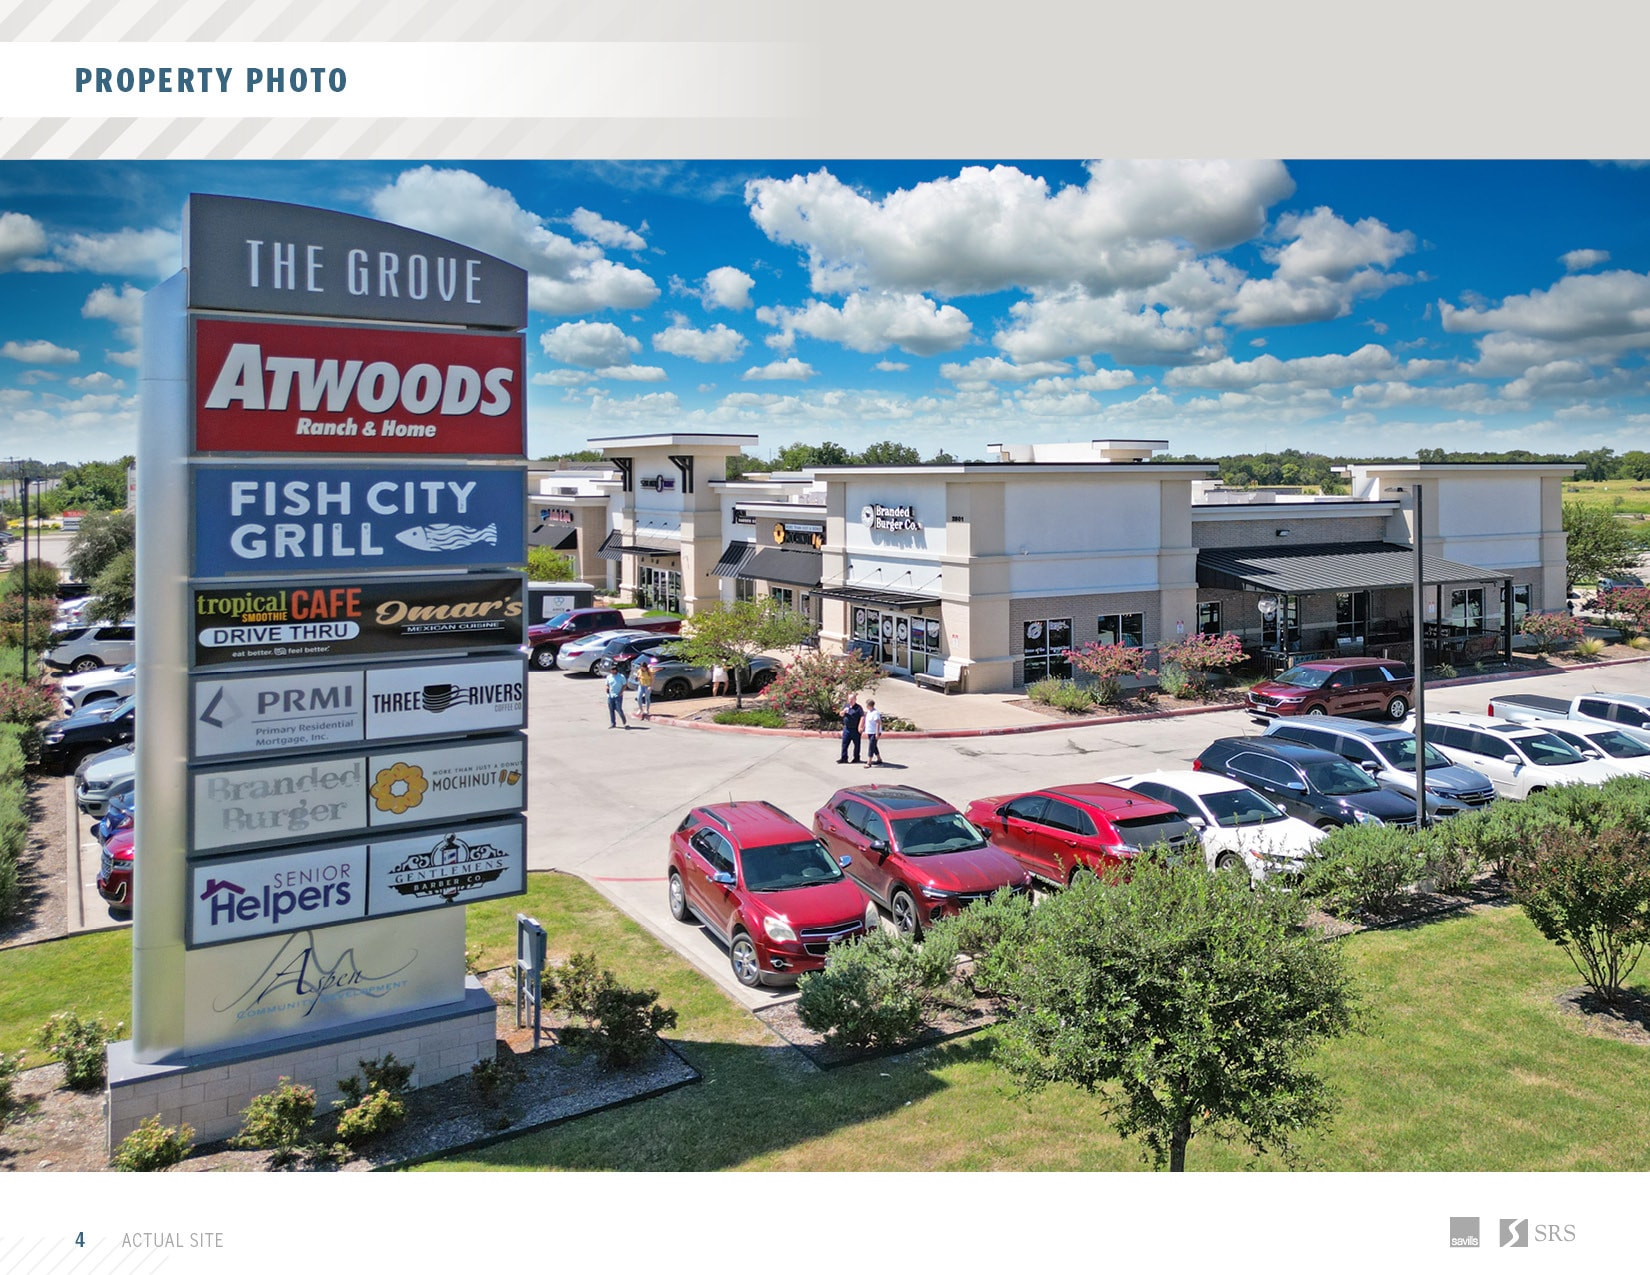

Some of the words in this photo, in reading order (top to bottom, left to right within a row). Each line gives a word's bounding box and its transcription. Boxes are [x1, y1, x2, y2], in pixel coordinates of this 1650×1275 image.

[246, 239, 324, 293] THE
[347, 248, 482, 304] GROVE
[204, 342, 514, 417] ATWOODS
[296, 417, 358, 436] Ranch
[361, 421, 377, 437] &
[381, 419, 437, 438] Home
[231, 481, 351, 516] FISH
[366, 481, 477, 515] CITY
[876, 505, 910, 518] Branded
[876, 517, 902, 532] Burger
[231, 523, 384, 559] GRILL
[197, 590, 288, 618] tropical
[291, 588, 362, 620] CAFE
[375, 596, 523, 625] Omar's
[242, 611, 288, 623] SMOOTHIE
[407, 624, 456, 633] MEXICAN
[458, 621, 500, 630] CUISINE
[213, 627, 283, 645] DRIVE
[289, 623, 348, 640] THRU
[257, 685, 352, 715] PRMI
[372, 691, 421, 714] THREE
[469, 682, 522, 705] RIVERS
[494, 704, 513, 713] COFFEE
[255, 735, 308, 747] Mortgage,
[311, 733, 329, 742] Inc.
[256, 725, 296, 736] Primary
[299, 719, 354, 732] Residential
[500, 760, 523, 768] DONUT
[207, 762, 361, 802] Branded
[432, 771, 497, 792] MOCHINUT
[222, 799, 348, 832] Burger
[274, 863, 351, 889] SENIOR
[395, 859, 503, 884] GENTLEMENS
[413, 879, 459, 892] BARBER
[211, 881, 351, 926] Helpers
[256, 947, 363, 1018] Aspen
